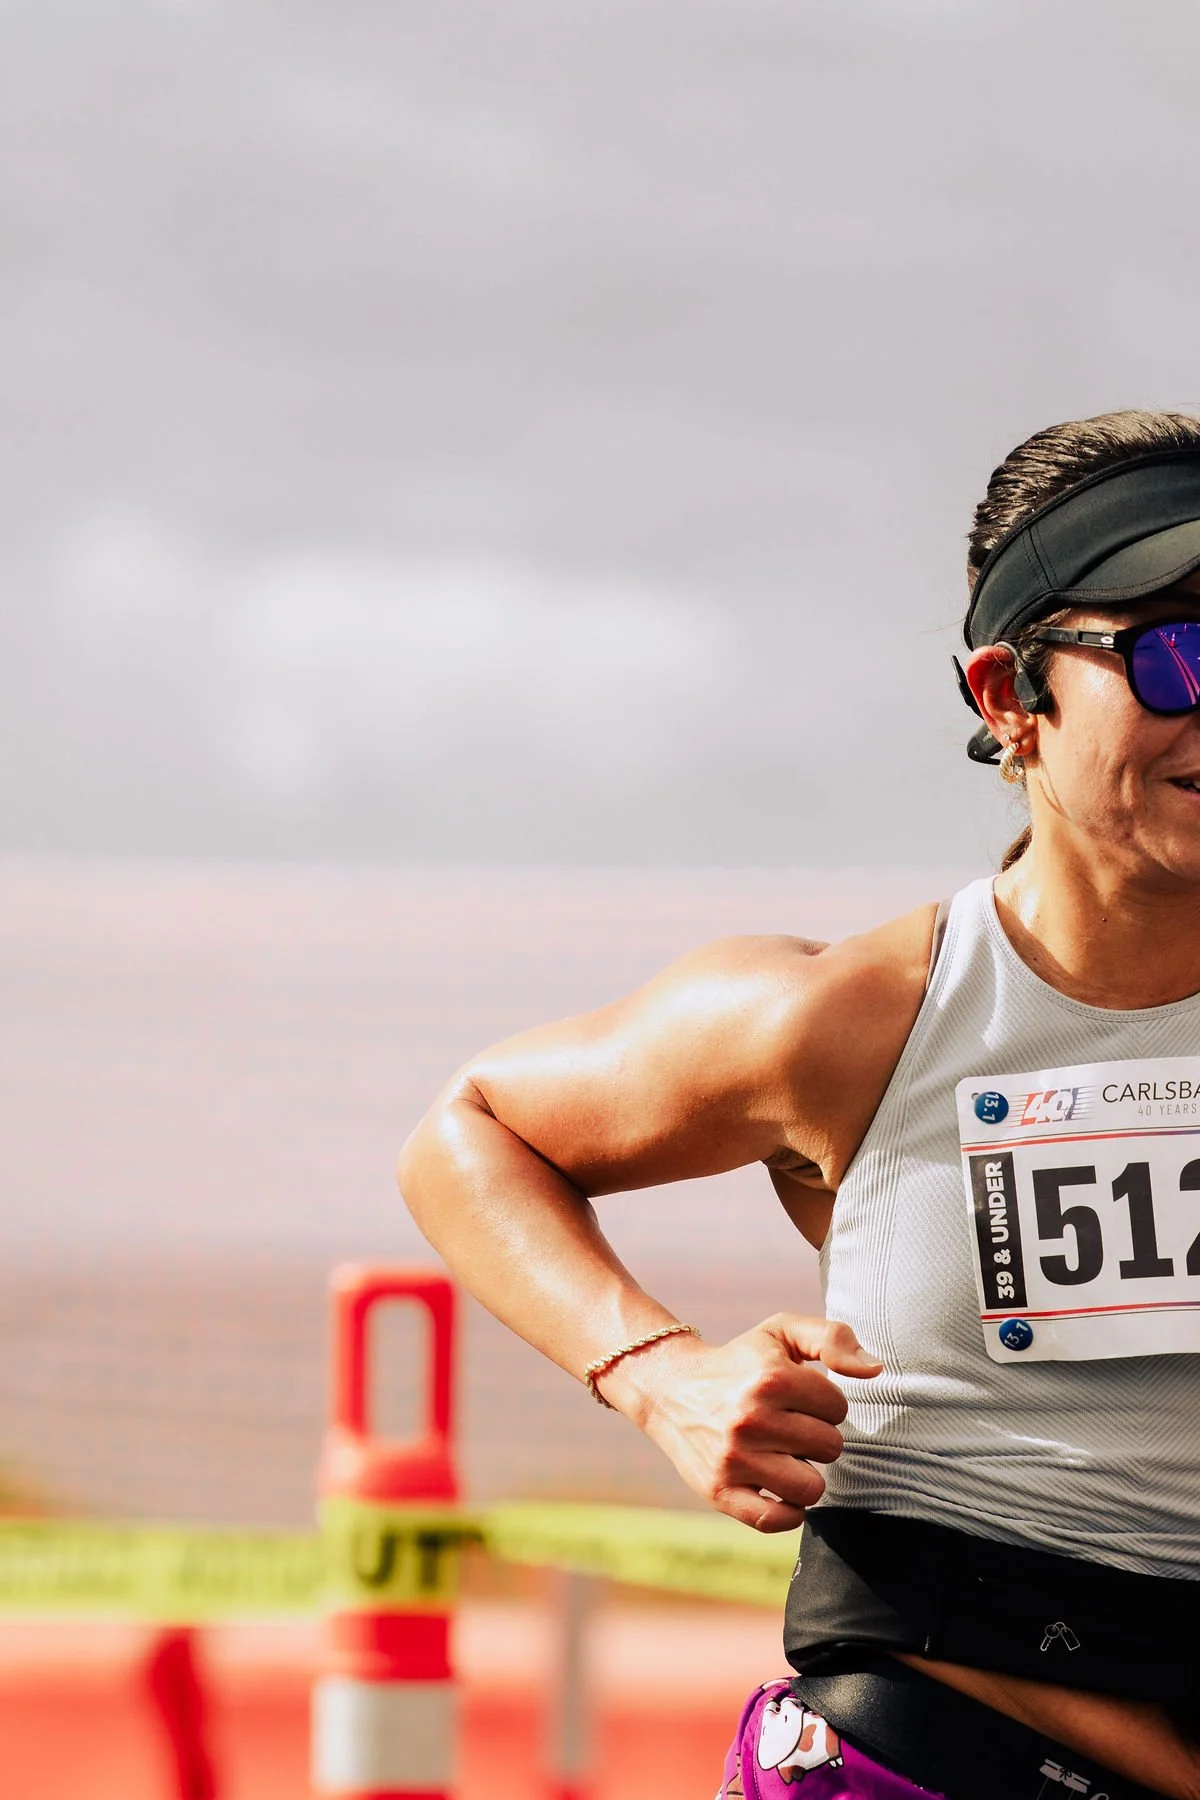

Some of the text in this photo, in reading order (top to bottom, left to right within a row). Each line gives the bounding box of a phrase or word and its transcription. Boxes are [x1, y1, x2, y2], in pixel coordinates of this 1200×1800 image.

[981, 1093, 1000, 1121] 13.1
[1137, 1105, 1152, 1117] 40
[1159, 1102, 1198, 1116] YEARS
[984, 1161, 1016, 1300] 39 & UNDER
[1003, 1320, 1029, 1348] 13.1
